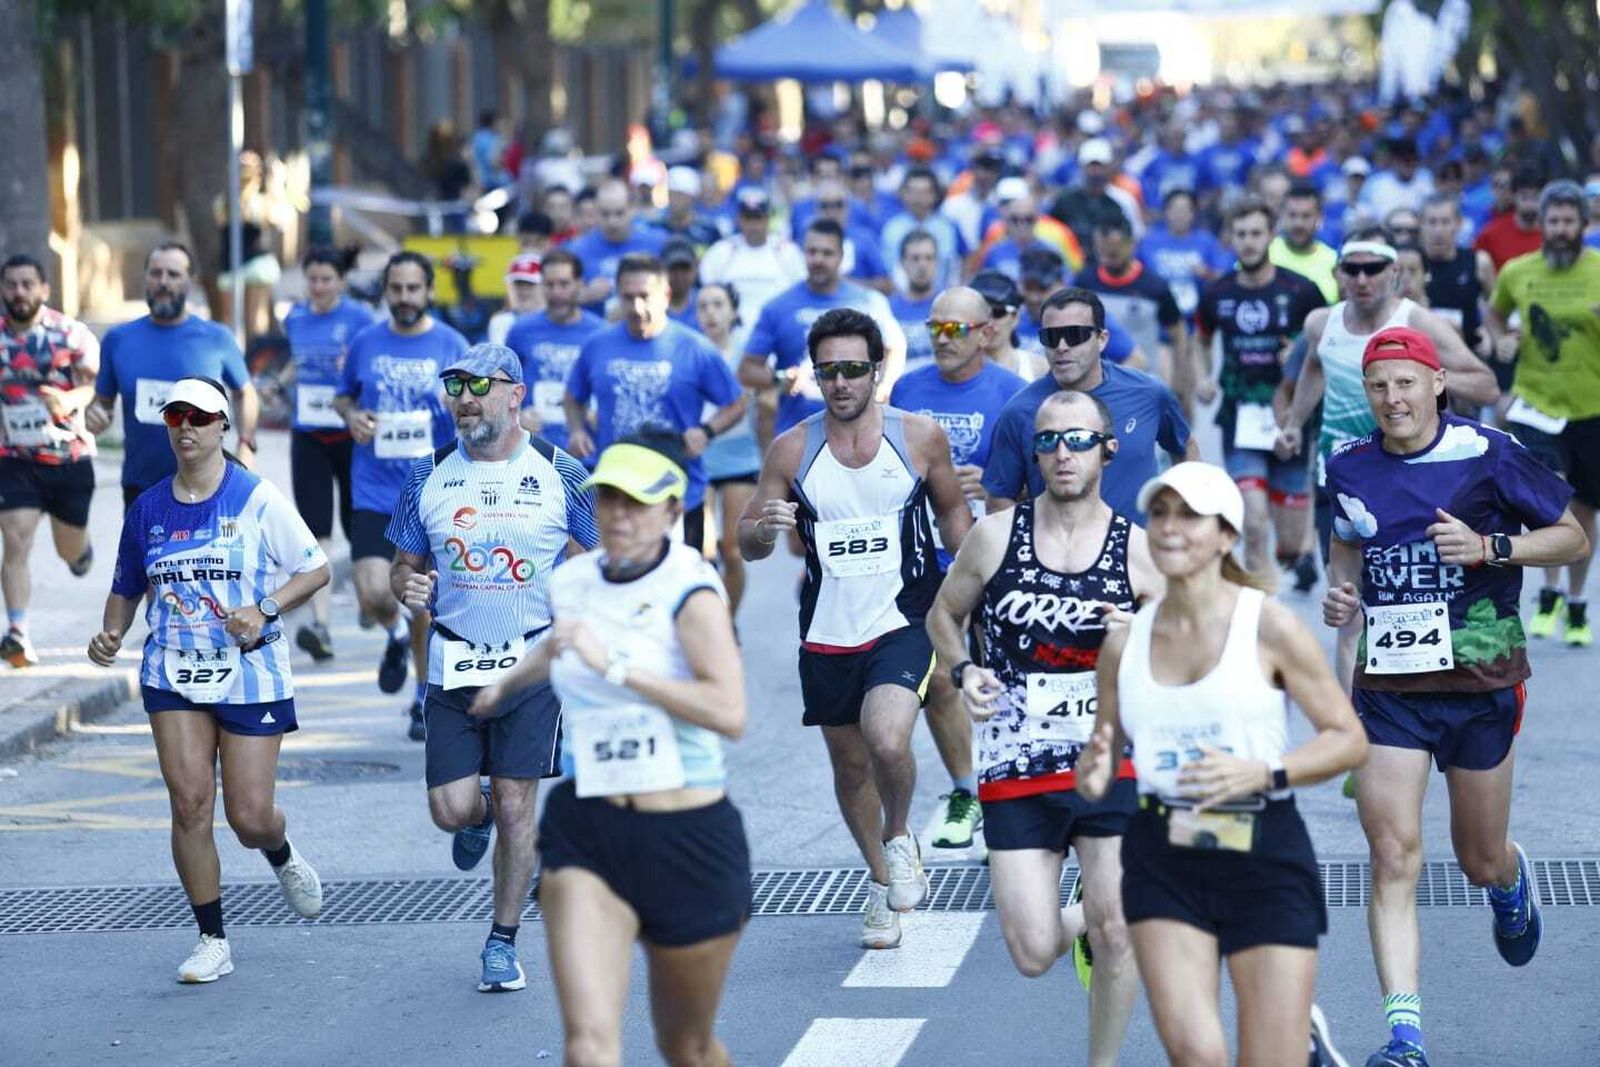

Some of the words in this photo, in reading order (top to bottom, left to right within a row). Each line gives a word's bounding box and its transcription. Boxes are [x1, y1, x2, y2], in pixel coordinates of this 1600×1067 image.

[828, 537, 888, 557] 583
[1366, 540, 1437, 564] GAM
[155, 556, 224, 568] ATLETISMO
[444, 537, 535, 582] 2020
[1368, 564, 1464, 589] OVER
[995, 590, 1104, 635] CORRE
[1376, 629, 1442, 648] 494
[455, 657, 517, 671] 680
[176, 667, 232, 684] 327
[594, 736, 655, 762] 521
